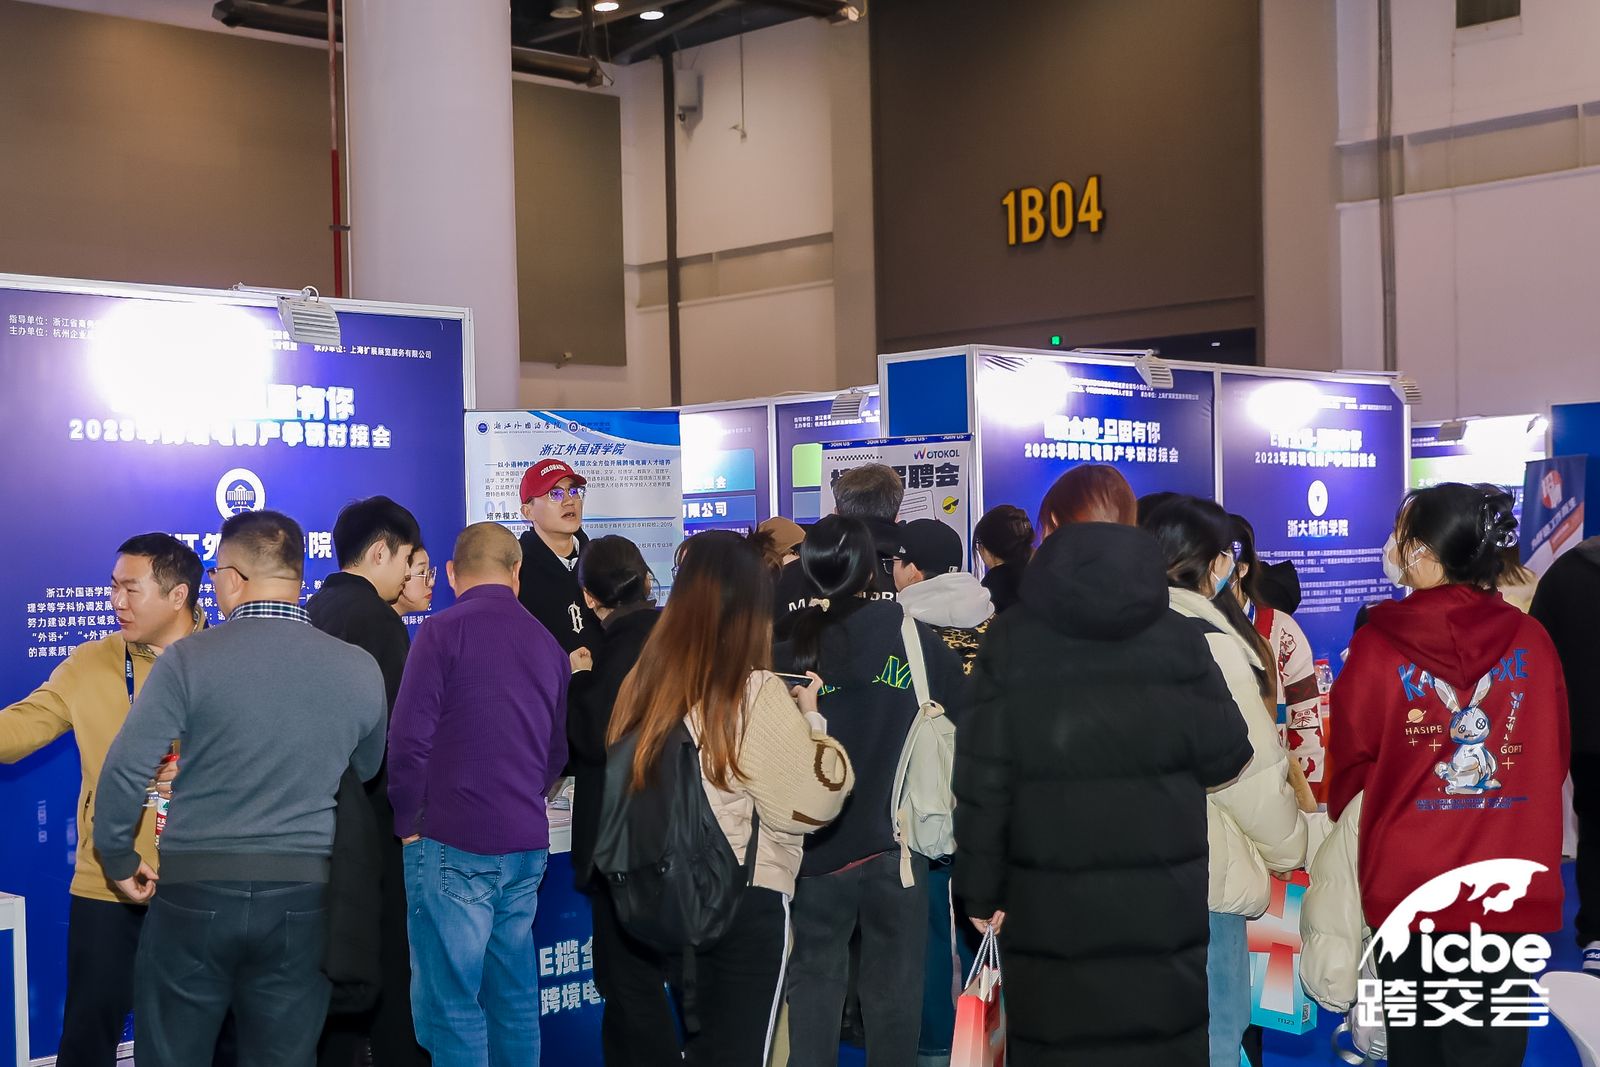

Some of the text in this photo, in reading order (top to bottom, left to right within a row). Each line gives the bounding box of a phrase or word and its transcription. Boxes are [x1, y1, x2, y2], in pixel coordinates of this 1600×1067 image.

[1002, 176, 1103, 245] 1B04
[539, 443, 627, 456] 浙江外国语学院
[487, 511, 519, 520] 培养模式
[1288, 519, 1348, 537] 浙大城市学院
[1405, 724, 1443, 737] HASIPE
